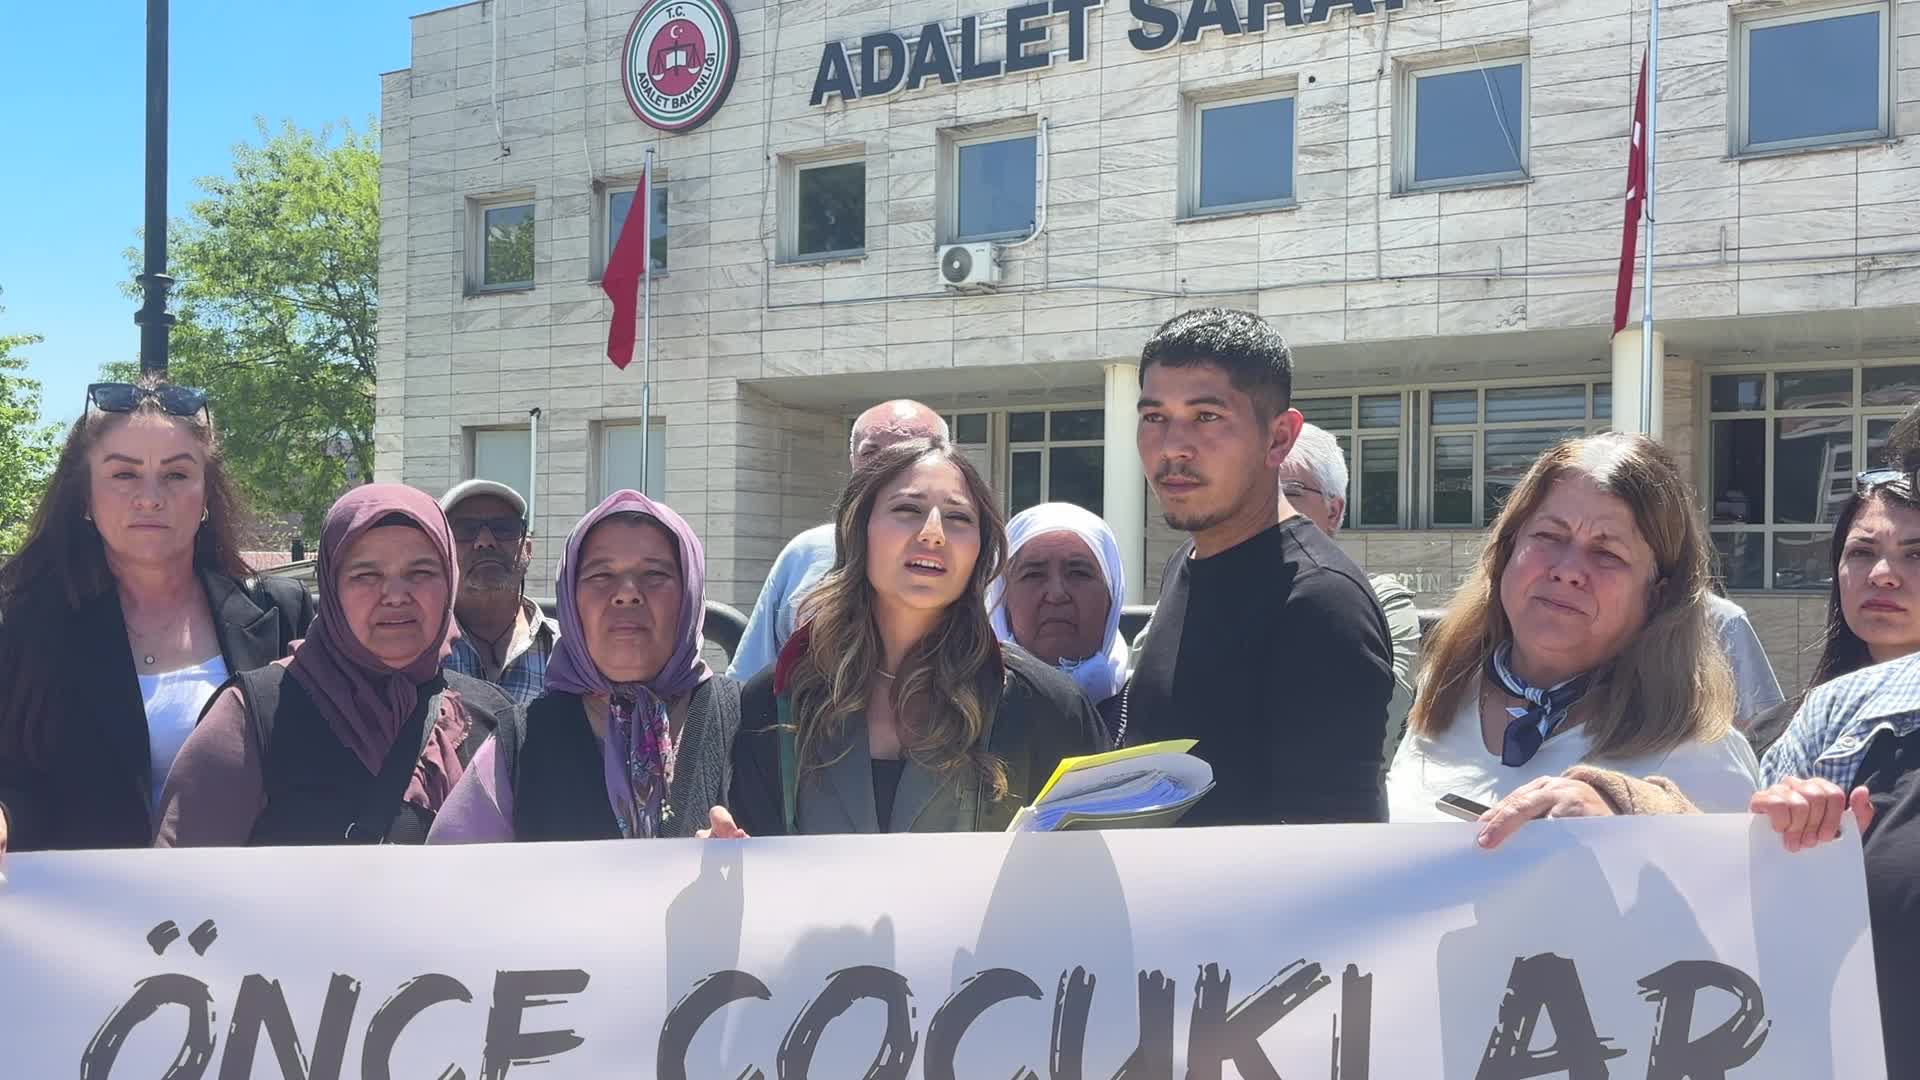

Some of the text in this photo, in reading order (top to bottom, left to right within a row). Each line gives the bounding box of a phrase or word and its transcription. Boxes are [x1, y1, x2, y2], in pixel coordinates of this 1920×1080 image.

[666, 6, 685, 19] T.C.
[809, 0, 1104, 106] ADALET
[638, 72, 669, 109] ADALET
